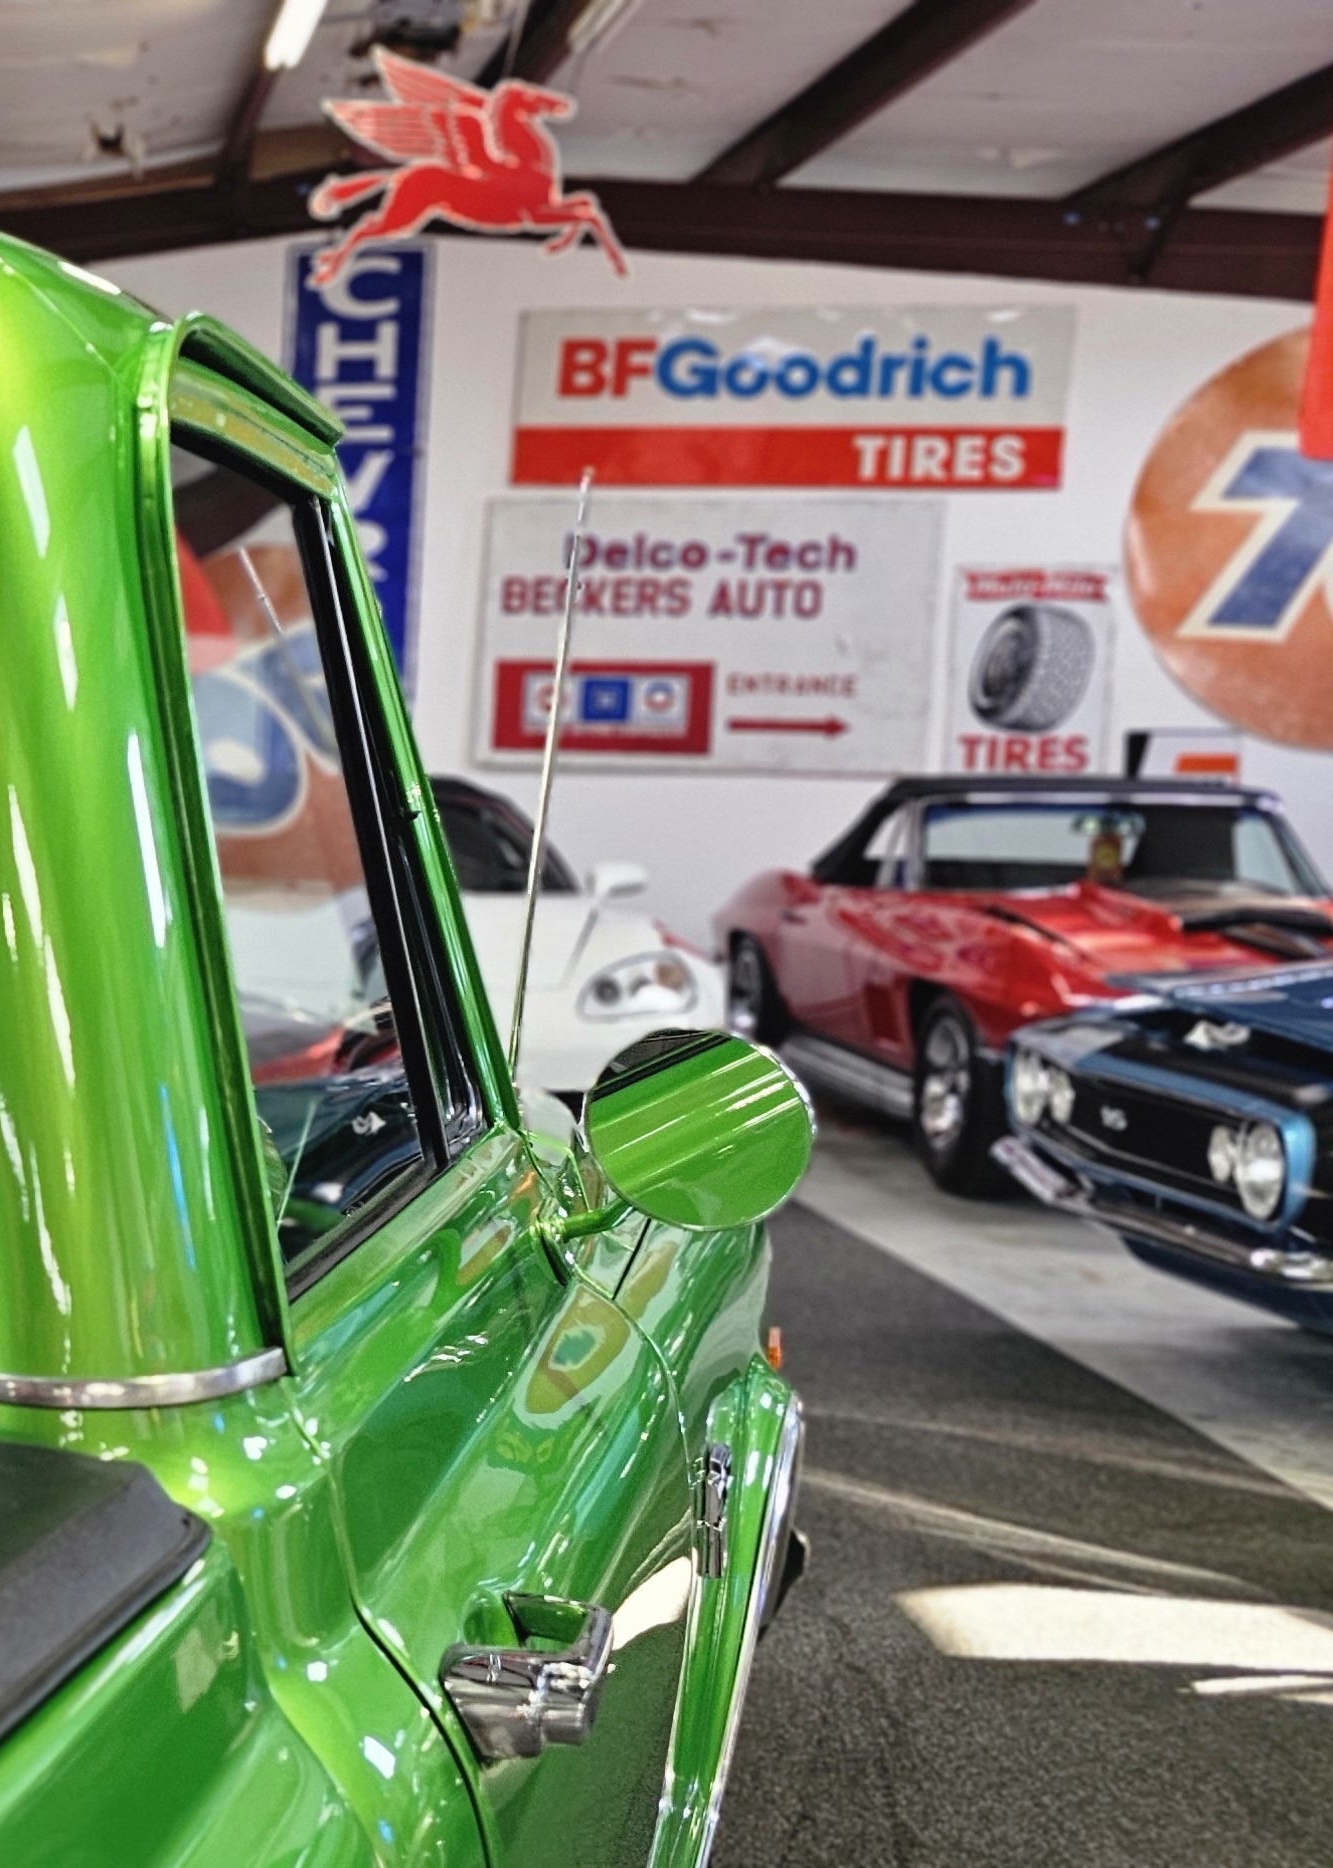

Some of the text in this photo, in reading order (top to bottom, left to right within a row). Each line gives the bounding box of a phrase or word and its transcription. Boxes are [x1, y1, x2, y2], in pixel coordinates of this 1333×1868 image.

[557, 334, 1030, 398] BFGoodrich
[852, 435, 1026, 482] TIRES
[707, 577, 823, 619] AUTO
[957, 733, 1089, 773] TIRES
